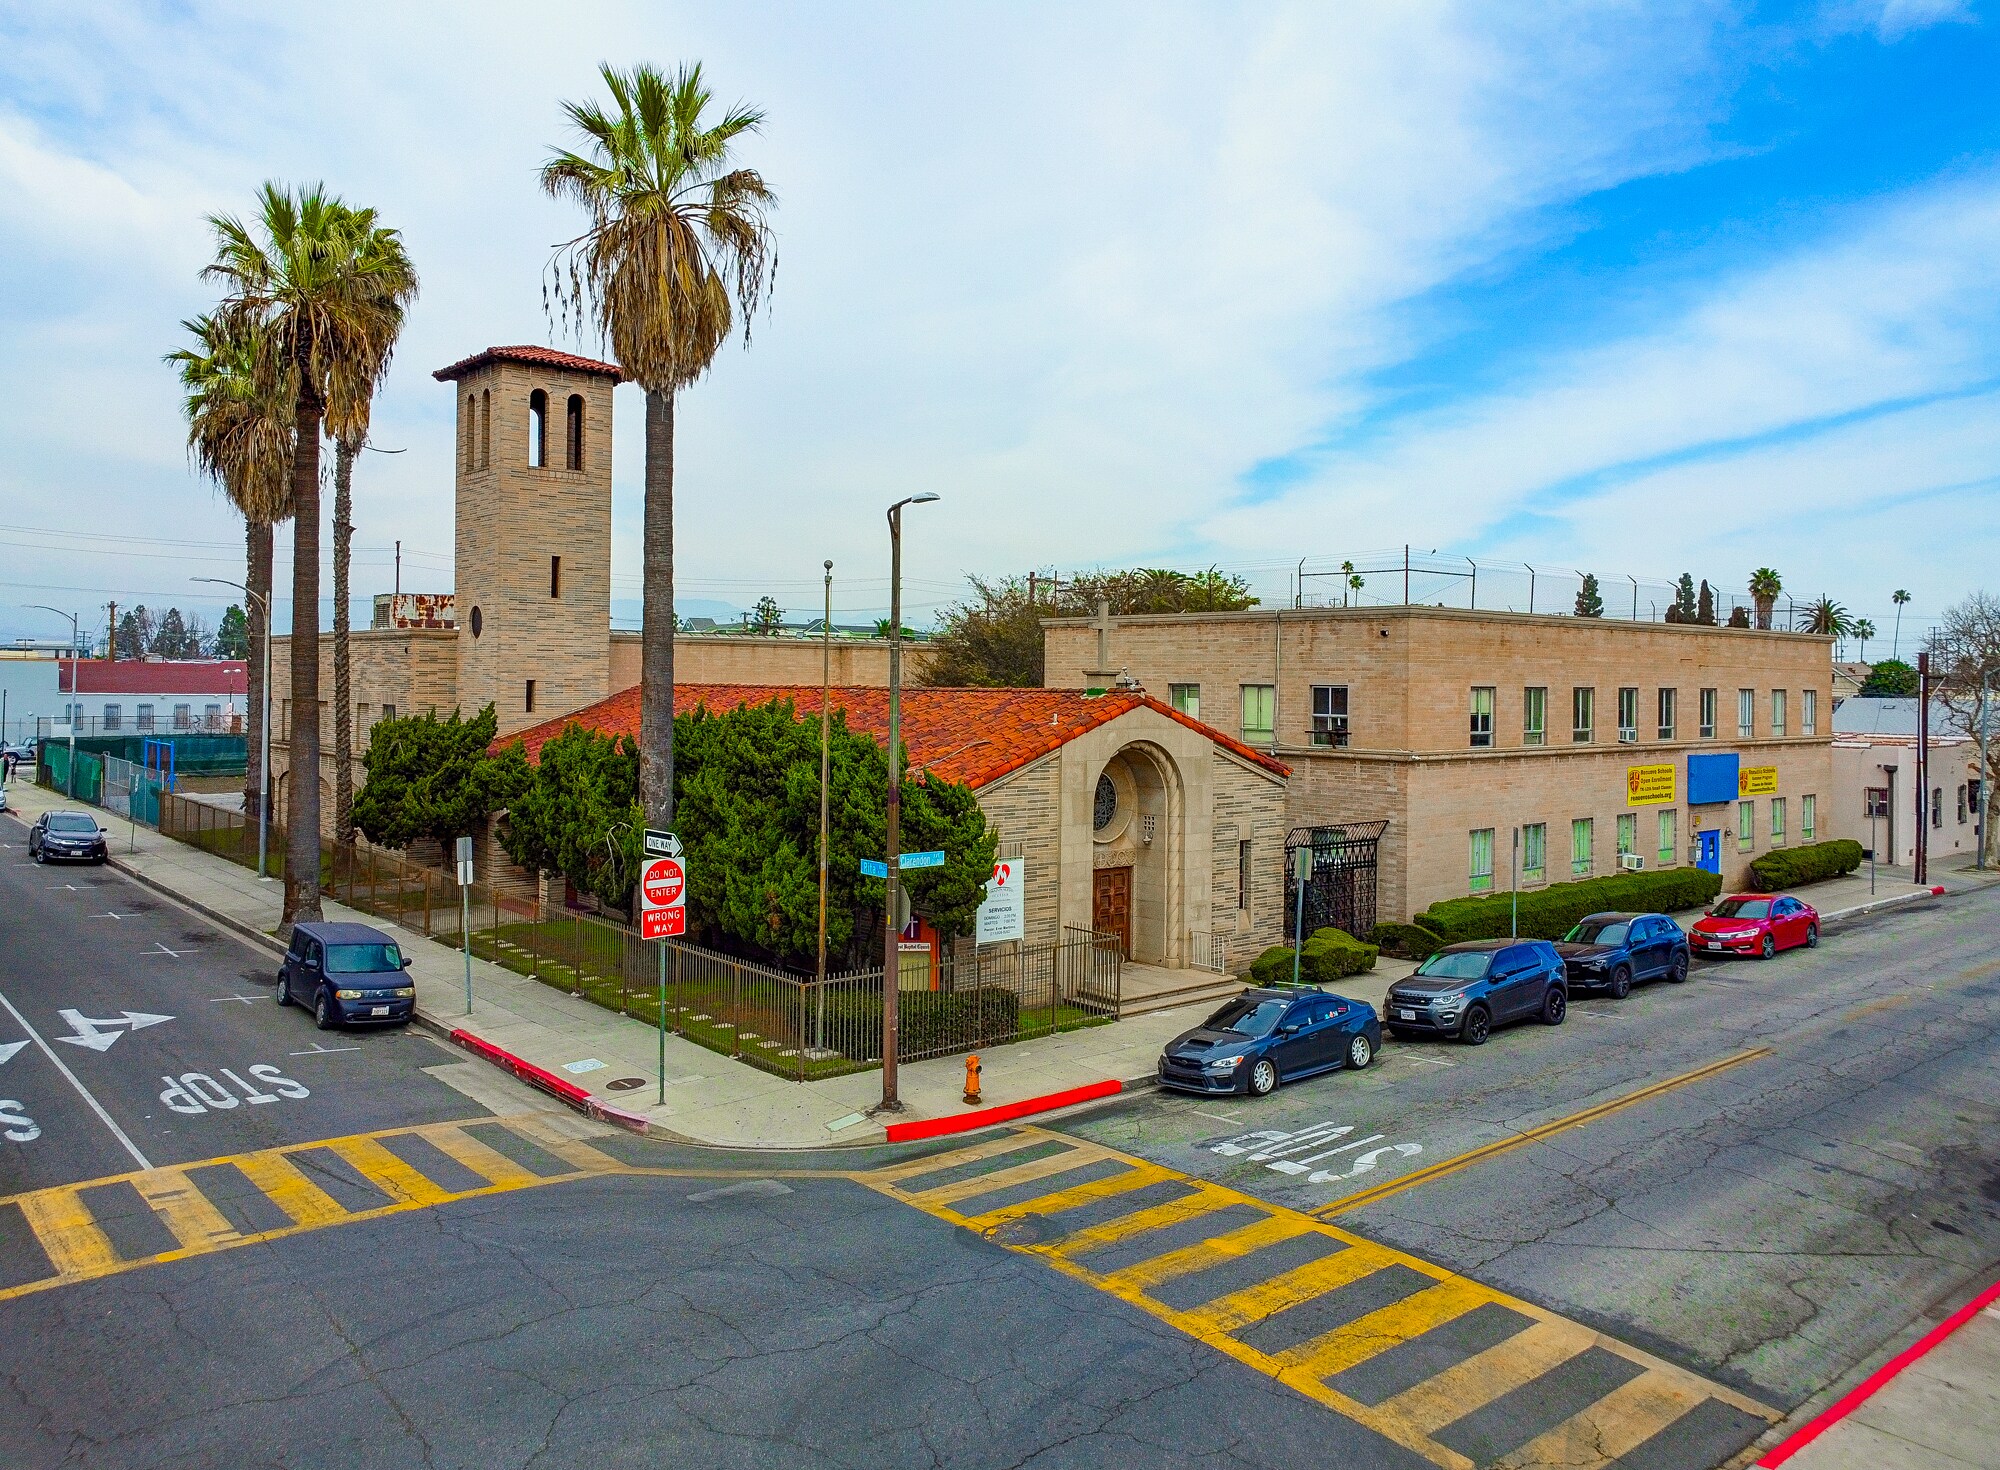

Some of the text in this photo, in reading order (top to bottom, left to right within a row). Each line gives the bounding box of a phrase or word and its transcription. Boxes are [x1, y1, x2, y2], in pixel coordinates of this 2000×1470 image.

[648, 837, 672, 851] ONE WAY
[863, 861, 876, 874] Rita
[900, 855, 931, 867] Clarendon
[649, 868, 678, 879] DO NOT
[650, 886, 677, 898] ENTER
[647, 909, 680, 922] WRONG
[653, 922, 674, 934] WAY
[159, 1064, 310, 1114] STOP
[1210, 1121, 1423, 1183] STOP
